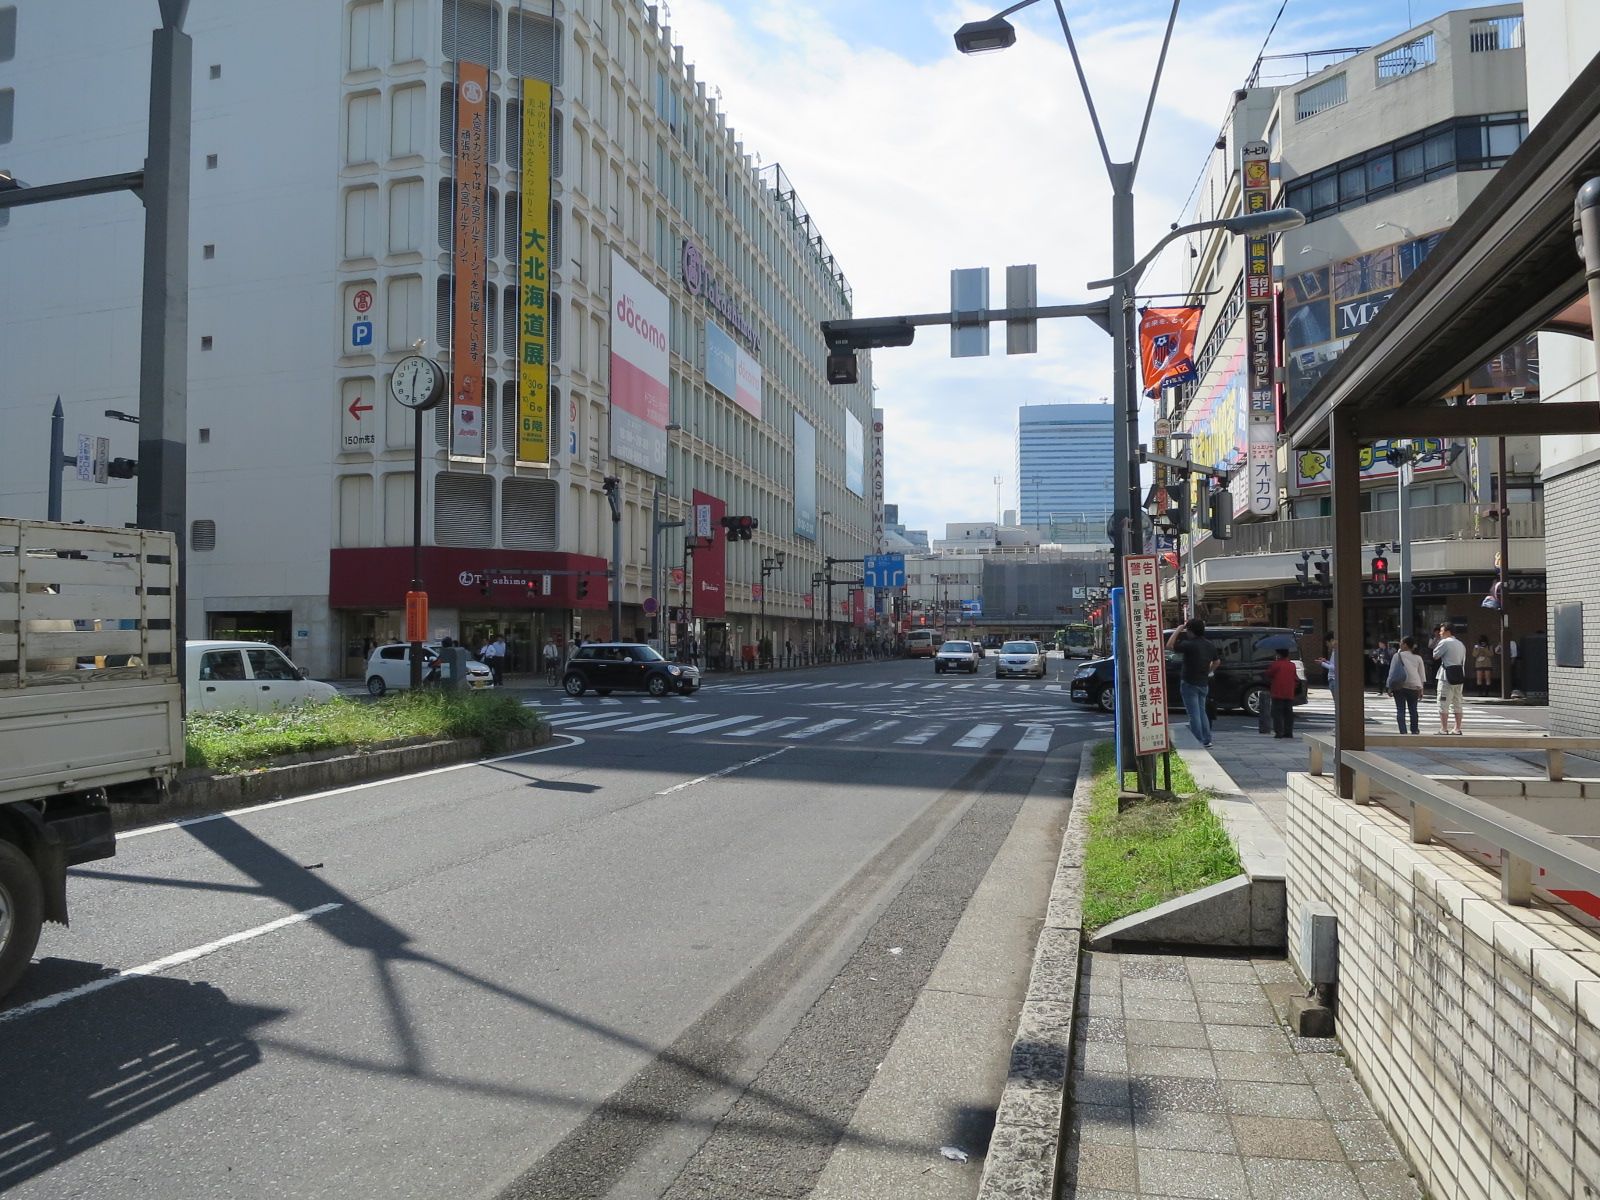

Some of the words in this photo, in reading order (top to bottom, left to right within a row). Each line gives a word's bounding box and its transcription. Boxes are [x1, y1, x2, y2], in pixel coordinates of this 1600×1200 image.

[524, 228, 546, 366] 大北海道展
[1250, 277, 1269, 288] 受付
[1251, 287, 1269, 297] 3F
[356, 326, 368, 343] P
[616, 294, 667, 353] docomo
[1252, 304, 1269, 388] インターネット
[1252, 401, 1272, 410] 2F
[874, 436, 884, 555] TAKASHIMAYA
[1255, 461, 1271, 511] オガワ
[1129, 562, 1153, 576] 警告
[1143, 581, 1164, 727] 自転車放置禁止
